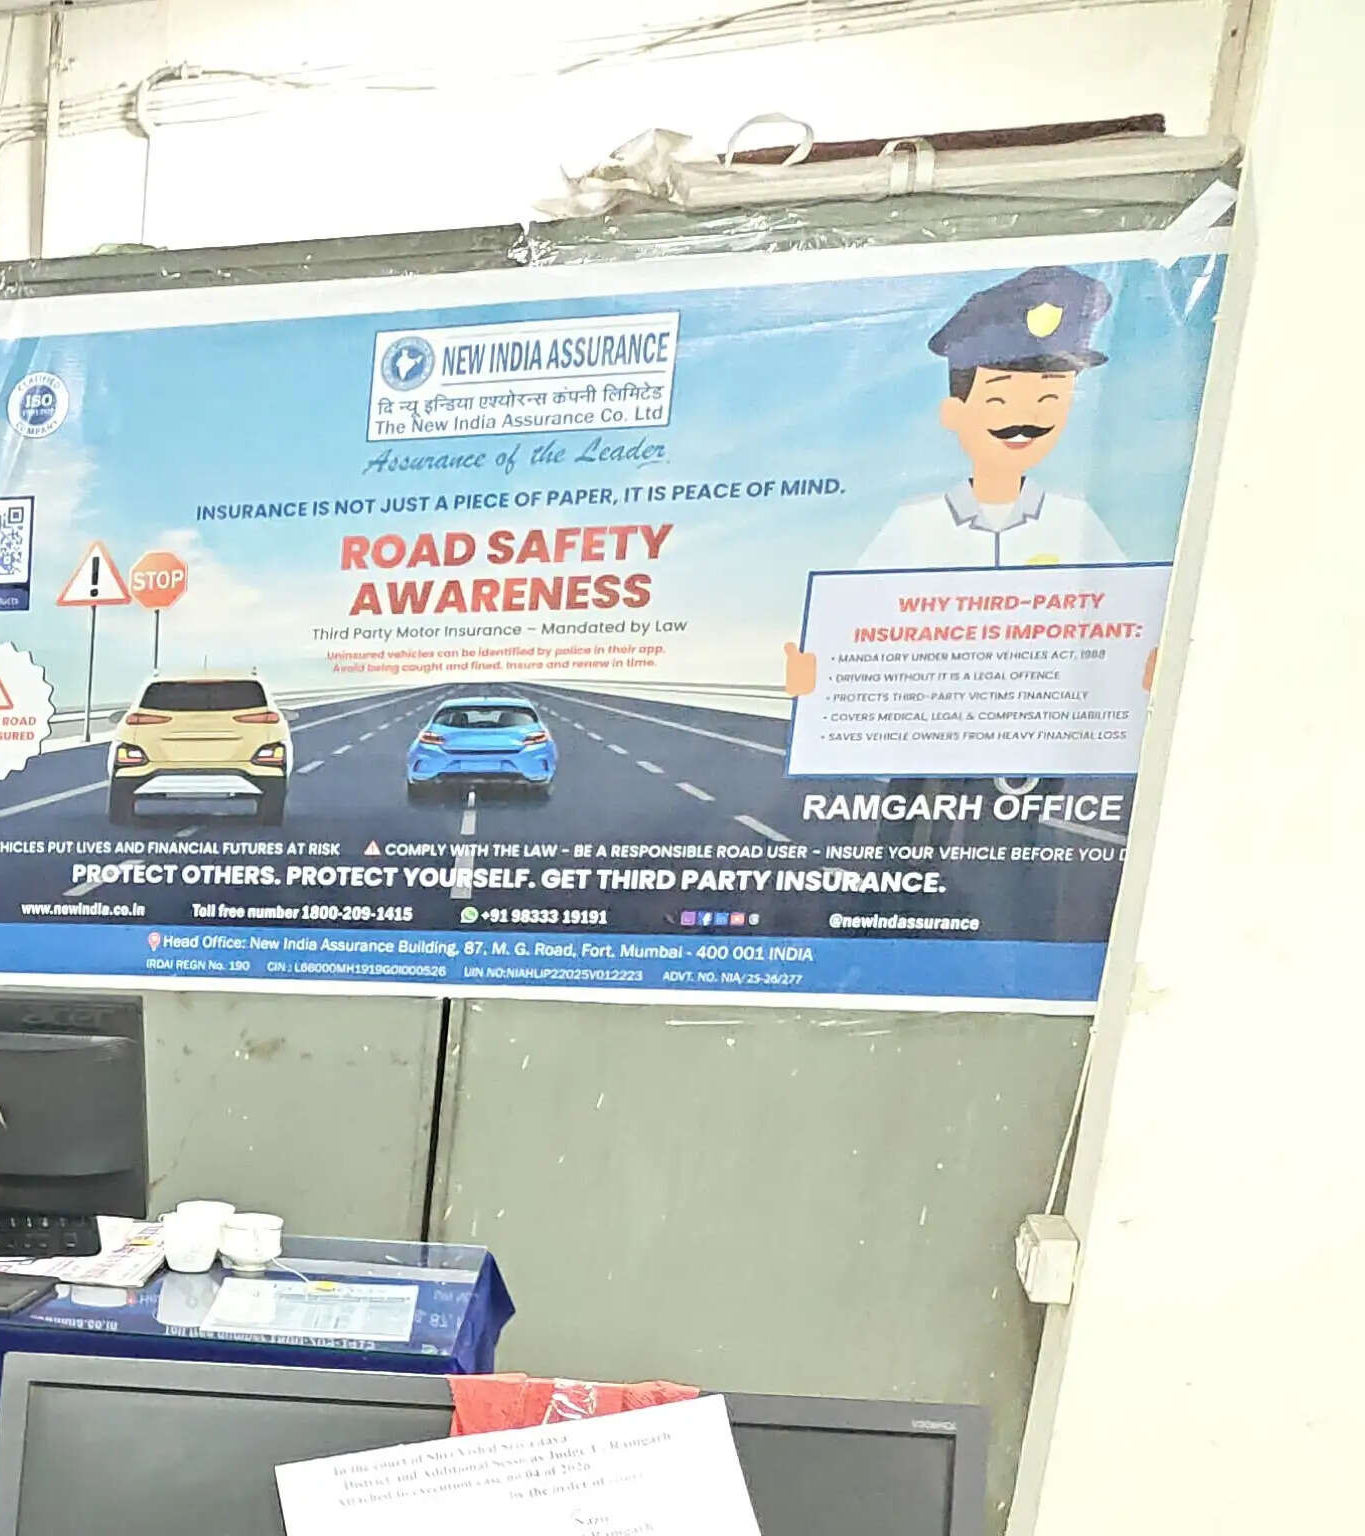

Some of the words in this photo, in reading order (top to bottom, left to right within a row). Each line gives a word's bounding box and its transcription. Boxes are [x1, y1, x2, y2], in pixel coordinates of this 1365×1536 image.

[442, 343, 484, 376] NEW
[489, 339, 542, 373] INDIA
[547, 332, 669, 370] ASSURANCE
[362, 448, 485, 475] Assurance
[496, 445, 519, 475] of
[530, 440, 565, 465] the
[575, 436, 666, 465] Leader
[197, 502, 307, 521] INSURANCE
[312, 501, 329, 516] IS
[334, 499, 376, 515] NOT
[380, 497, 431, 514] JUST
[435, 496, 448, 510] A
[454, 492, 509, 510] PIECE
[514, 491, 543, 507] OF
[547, 488, 619, 506] PAPER,
[624, 487, 646, 503] IT
[648, 486, 666, 501] IS
[671, 482, 741, 500] PEACE
[746, 481, 775, 497] OF
[781, 478, 845, 497] MIND.
[341, 532, 476, 570] ROAD
[486, 523, 674, 564] SAFETY
[132, 571, 184, 590] STOP
[349, 573, 652, 616] AWARENESS
[899, 597, 955, 612] WHY
[956, 593, 1106, 611] THIRD-PARTY
[312, 627, 349, 641] Third
[354, 626, 392, 642] Party
[396, 626, 440, 639] Motor
[445, 624, 521, 637] Insurance
[541, 621, 625, 635] Mandated
[631, 620, 651, 636] by
[655, 620, 687, 632] Law
[854, 625, 977, 643] INSURANCE
[981, 625, 1002, 640] IS
[1006, 622, 1143, 640] IMPORTANT:
[3, 717, 36, 725] ROAD
[802, 794, 981, 821] RAMGARH
[993, 794, 1124, 821] OFFICE
[72, 864, 178, 884] PROTECT
[181, 865, 281, 885] OTHERS.
[286, 866, 398, 887] PROTECT
[404, 867, 535, 889] YOURSELF.
[541, 869, 591, 889] GET
[597, 869, 676, 890] THIRD
[681, 870, 773, 891] PARTY
[776, 871, 947, 894] INSURANCE.
[192, 903, 215, 918] Toll
[219, 904, 245, 918] free
[248, 905, 299, 920] number
[302, 905, 412, 922] 1800-209-1415
[511, 909, 558, 923] 98333
[562, 910, 607, 924] 19191
